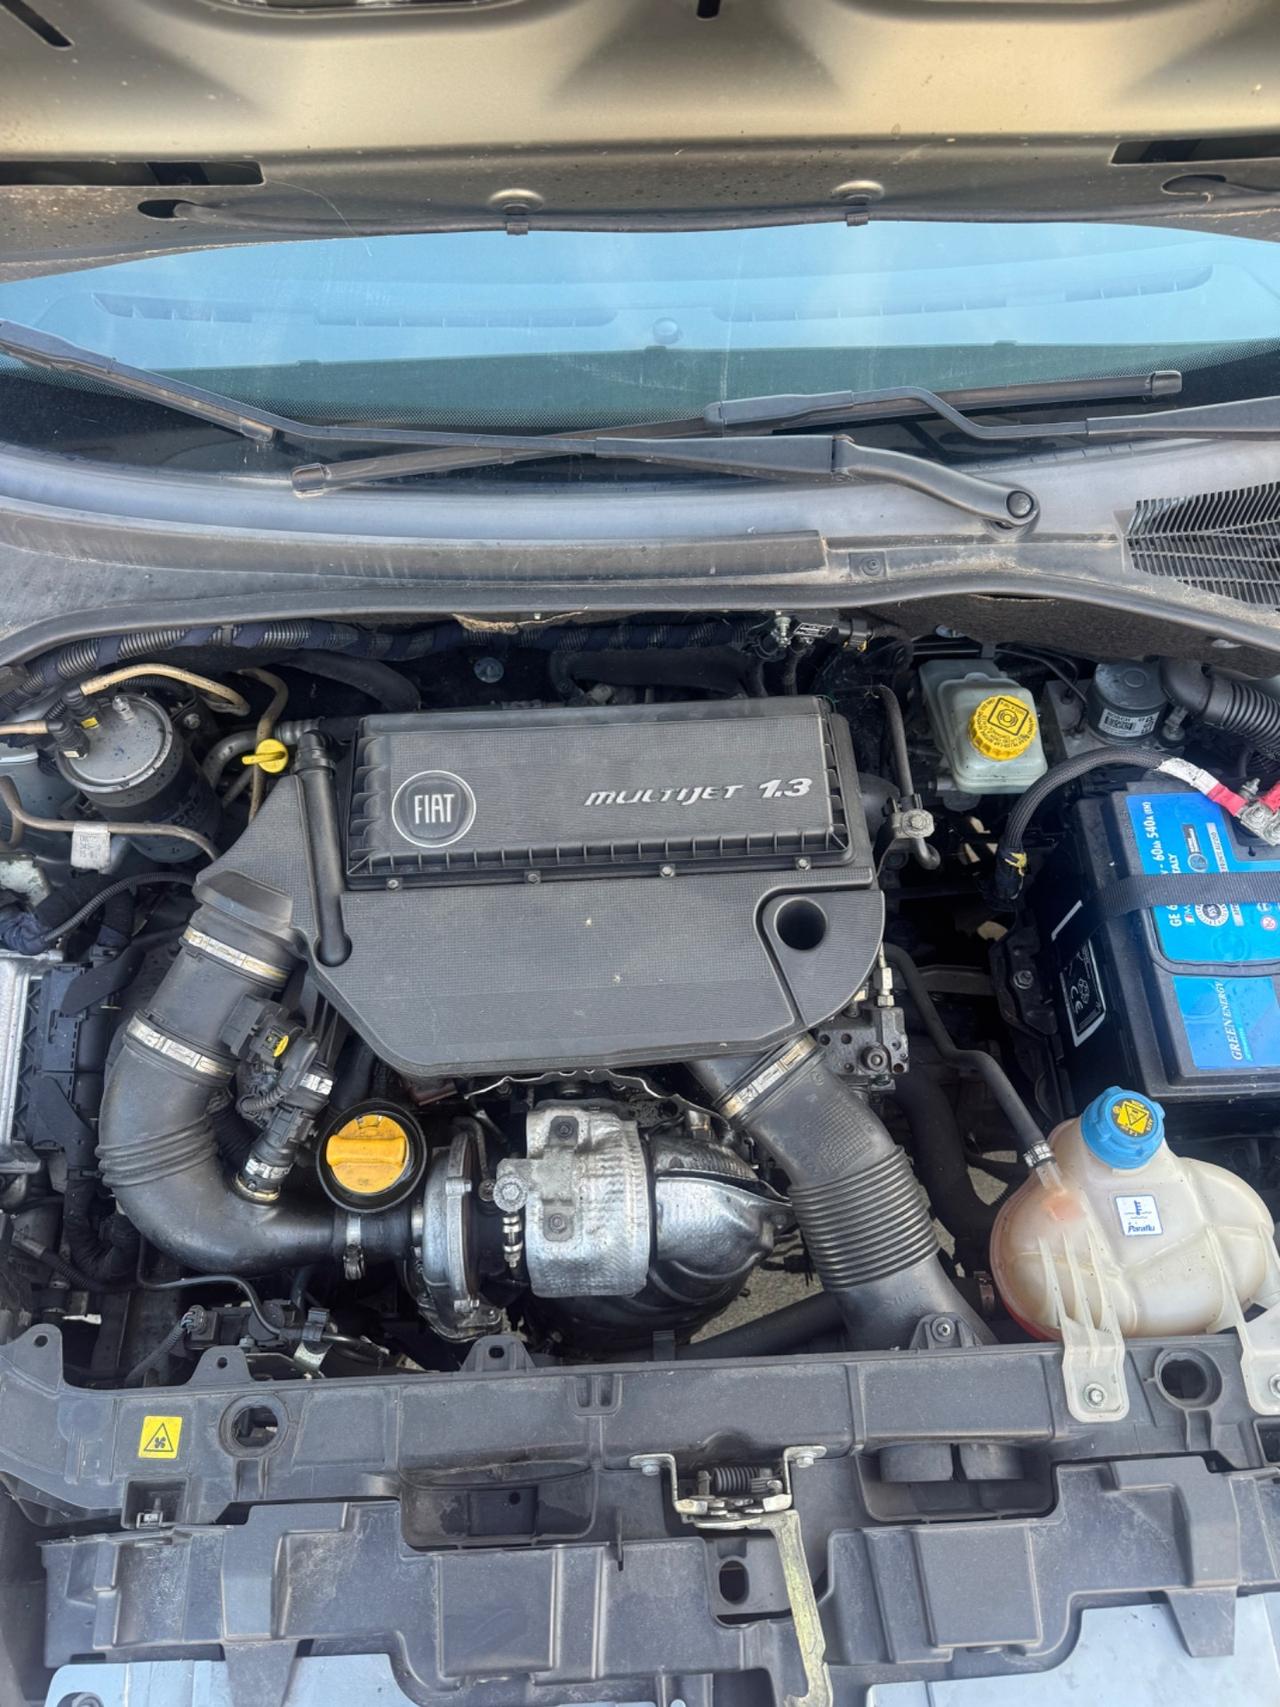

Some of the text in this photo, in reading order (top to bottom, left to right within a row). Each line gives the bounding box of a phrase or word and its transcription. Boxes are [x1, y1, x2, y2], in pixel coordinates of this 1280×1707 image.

[584, 777, 812, 806] MULTIJET 1.3
[414, 793, 454, 825] FIAT
[1215, 980, 1243, 1060] GREEN ENERGY
